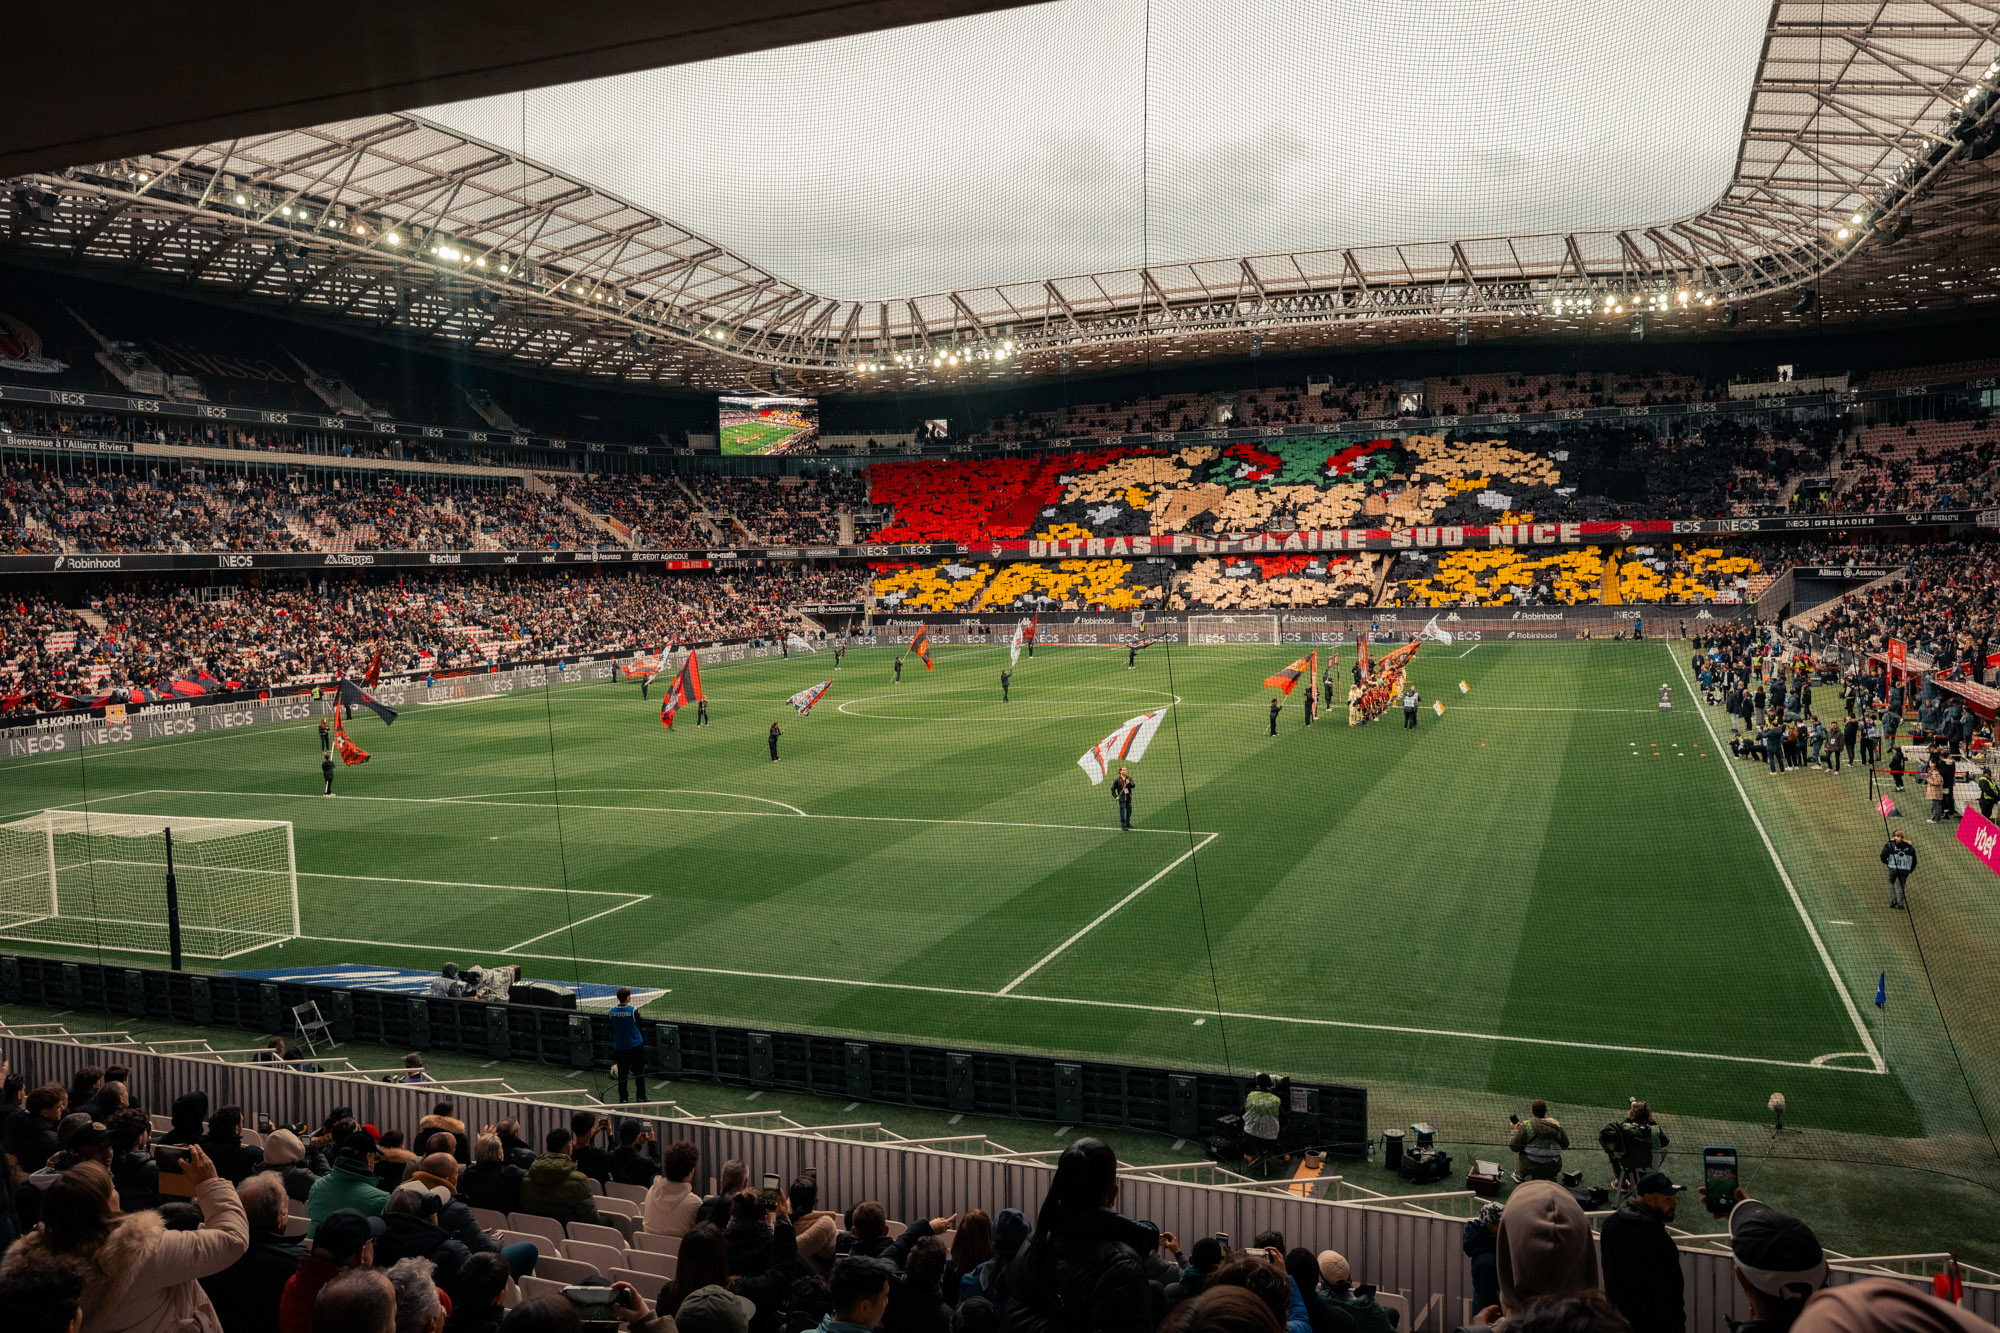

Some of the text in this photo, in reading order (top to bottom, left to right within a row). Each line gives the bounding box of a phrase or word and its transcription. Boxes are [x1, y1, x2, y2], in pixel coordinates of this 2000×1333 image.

[1966, 378, 1996, 389] INEOS
[1896, 386, 1927, 397] INEOS
[51, 391, 85, 405] INEOS
[1755, 398, 1786, 408] INEOS
[1825, 393, 1856, 403] INEOS
[128, 399, 159, 412] INEOS
[1687, 403, 1716, 412] INEOS
[198, 405, 227, 418] INEOS
[1555, 410, 1583, 419] INEOS
[1620, 407, 1649, 416] INEOS
[262, 411, 288, 423] INEOS
[1432, 417, 1458, 426] INEOS
[1494, 414, 1520, 423] INEOS
[320, 417, 344, 429] INEOS
[1373, 421, 1398, 429] INEOS
[1259, 427, 1283, 435] INEOS
[1315, 424, 1340, 433] INEOS
[1205, 430, 1228, 439] INEOS
[7, 436, 128, 452] Bienvenue à l'Allianz Riviera
[1672, 522, 1700, 533] EOS
[1718, 520, 1759, 531] INEOS
[1785, 517, 1875, 528] INEOS GRENADIER
[1029, 536, 1151, 557] ULTRAS
[1391, 526, 1463, 547] SUD
[1489, 522, 1581, 545] NICE
[707, 551, 737, 559] nice-matin
[857, 546, 888, 557] INEOS
[901, 545, 931, 555] INEOS
[218, 555, 253, 567] INEOS
[337, 555, 374, 565] Kappa
[437, 553, 460, 563] actual
[68, 558, 120, 569] Robinhood
[1818, 569, 1841, 577] Allianz
[1522, 612, 1563, 620] Robinhood
[1614, 611, 1640, 619] INEOS
[851, 636, 877, 644] INEOS
[889, 635, 914, 644] INEOS
[926, 635, 950, 644] NEOS
[959, 634, 986, 644] INEOS
[1034, 634, 1060, 643] NEOS
[1068, 633, 1097, 643] INEOS
[1311, 632, 1344, 641] INEOS
[1451, 631, 1481, 640] NEOS
[390, 676, 412, 687] NICE
[427, 687, 449, 701] LIGUE
[37, 718, 48, 728] LE
[50, 715, 73, 726] KOP
[74, 713, 91, 723] DU
[165, 702, 190, 712] CLUB
[271, 704, 310, 722] INEOS
[211, 711, 253, 730] INEOS
[150, 718, 195, 737] INEOS
[81, 725, 132, 746] INEOS
[10, 734, 65, 756] INEOS
